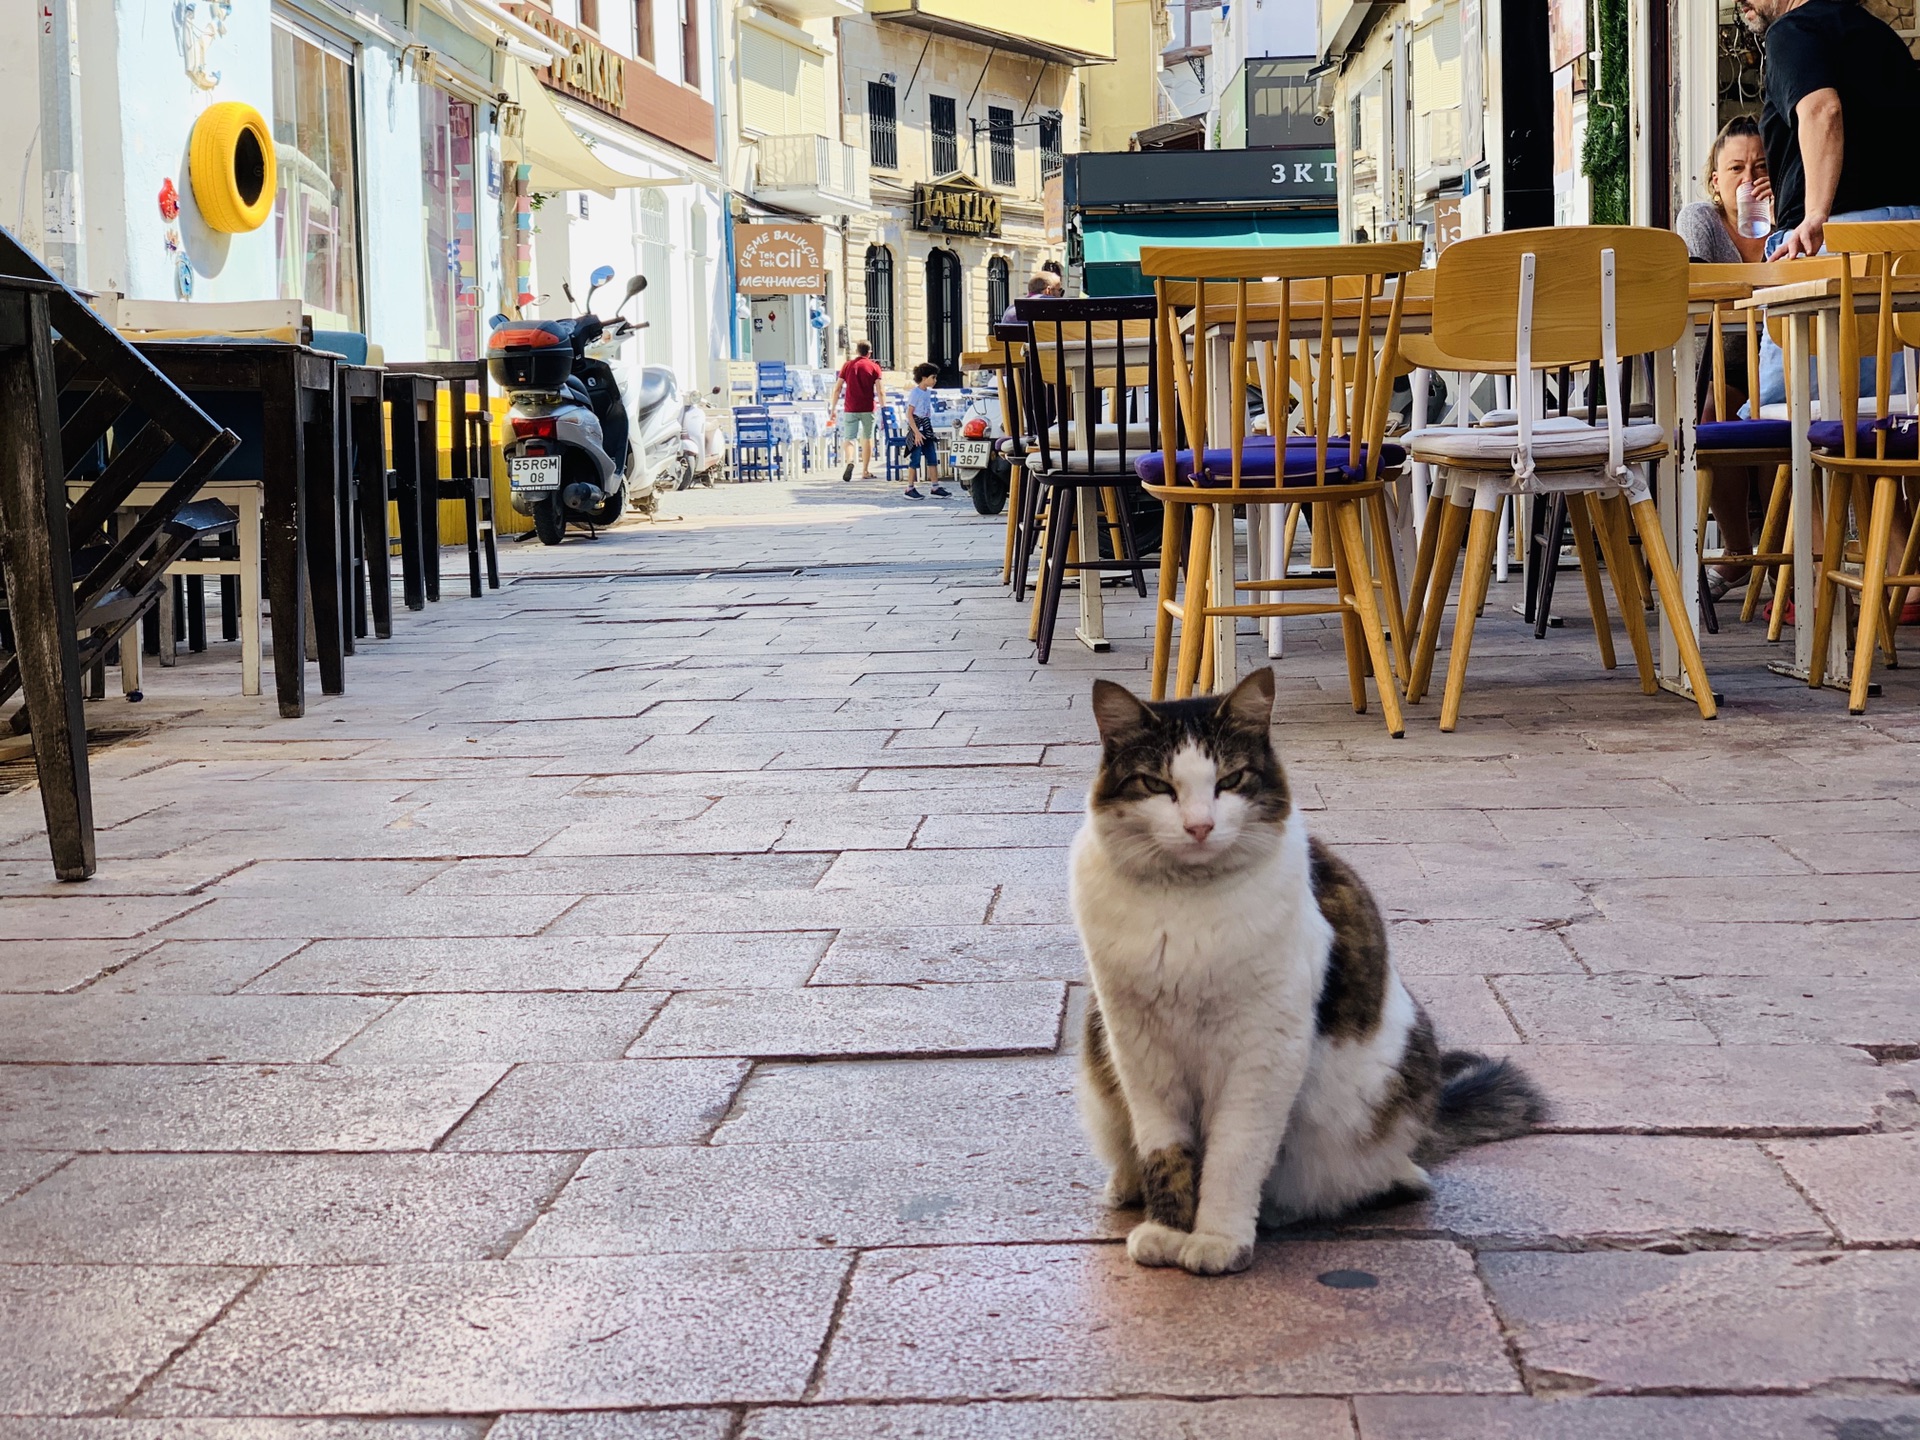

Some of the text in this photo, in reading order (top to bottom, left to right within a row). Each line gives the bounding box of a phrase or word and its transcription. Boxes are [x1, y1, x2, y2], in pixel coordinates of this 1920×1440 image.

[44, 21, 52, 34] 2
[740, 230, 820, 268] ÇEŞME BALIKÇISI
[758, 251, 775, 259] Tek
[758, 259, 775, 268] Tek
[952, 443, 986, 454] 35 AGL
[513, 458, 557, 471] 35RGM
[959, 455, 980, 465] 367
[529, 472, 545, 483] 08
